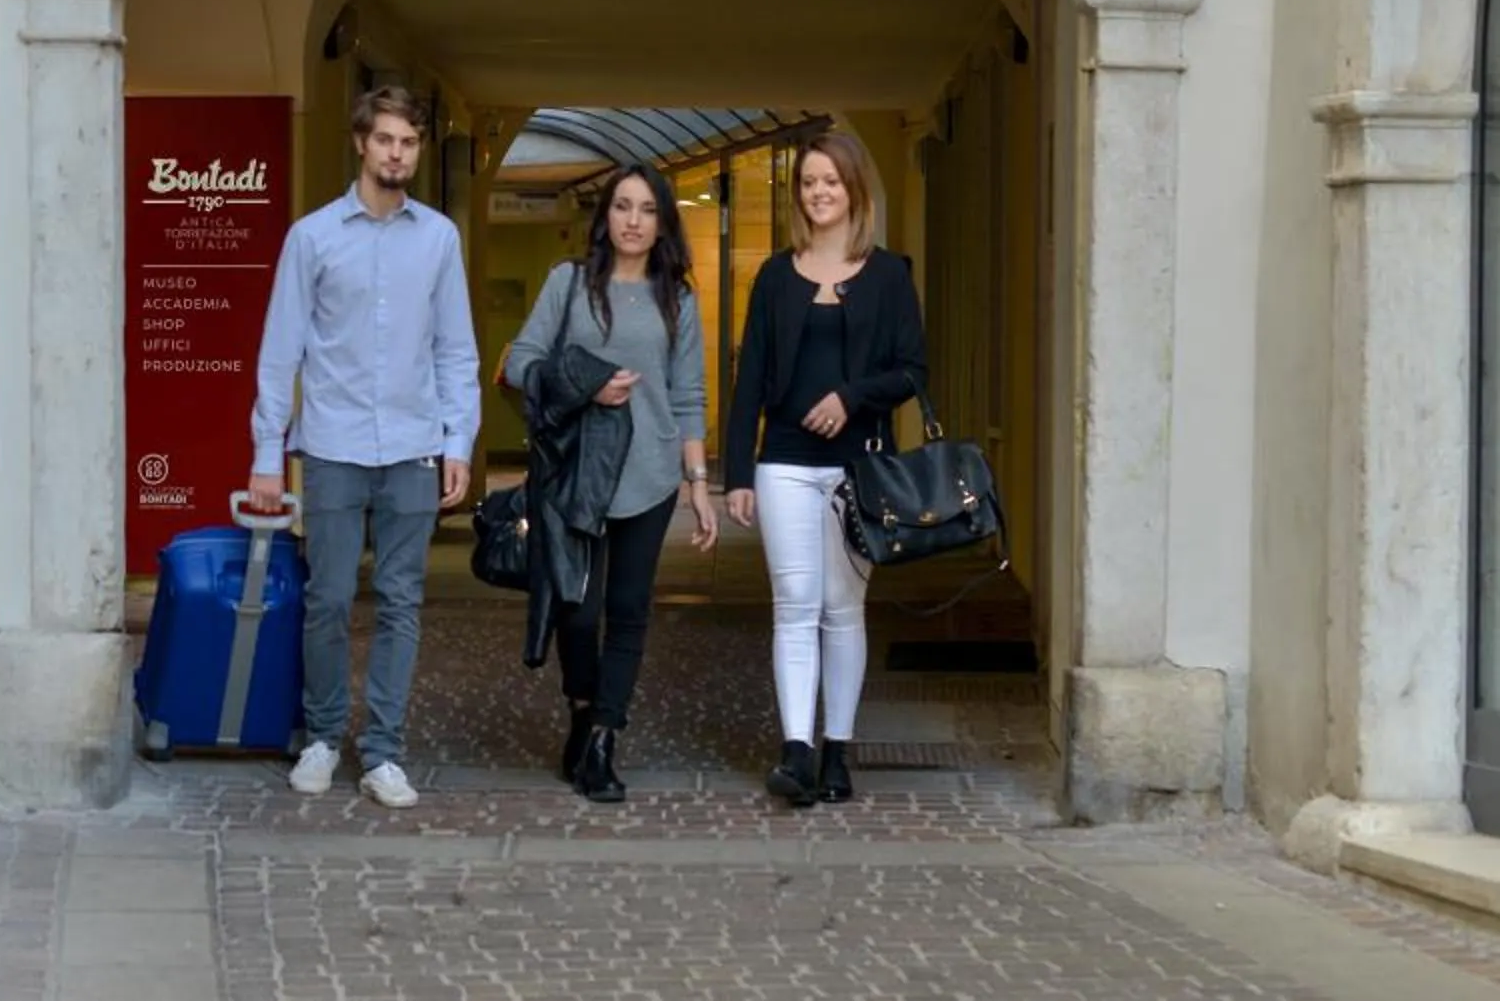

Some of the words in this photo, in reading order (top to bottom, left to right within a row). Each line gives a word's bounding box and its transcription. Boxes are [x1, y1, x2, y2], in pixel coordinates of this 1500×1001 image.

[188, 196, 224, 211] 1790
[180, 217, 234, 227] ANTICA
[143, 278, 197, 289] MUSEO
[143, 299, 231, 310] ACCADEMIA
[143, 319, 185, 331] SHOP
[143, 339, 190, 351] UFFICI
[143, 360, 242, 372] PRODUZIONE
